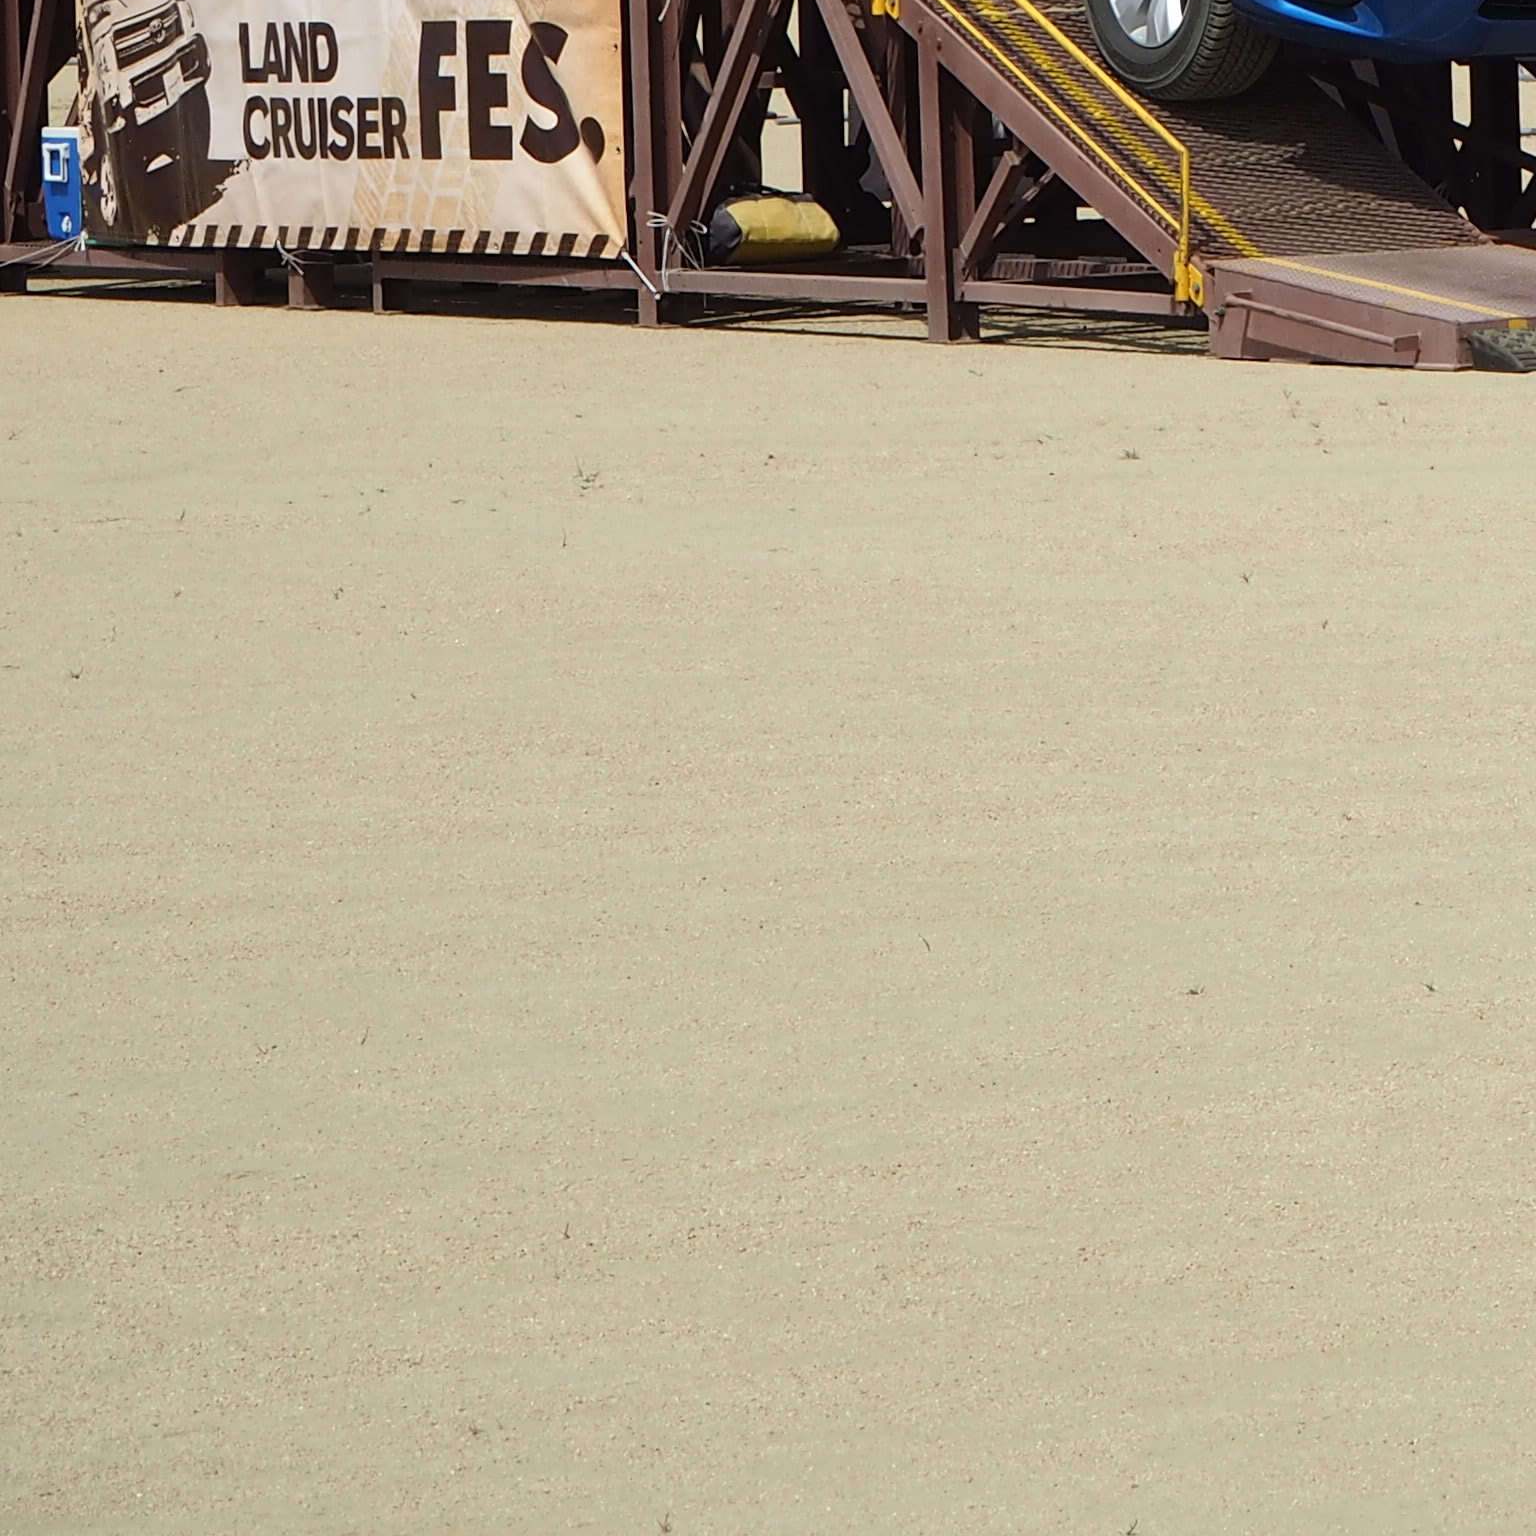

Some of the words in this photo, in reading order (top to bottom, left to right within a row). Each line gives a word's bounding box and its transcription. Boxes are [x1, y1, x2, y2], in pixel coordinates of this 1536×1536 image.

[238, 21, 339, 84] LAND
[417, 19, 606, 165] FES.
[242, 95, 411, 161] CRUISER
